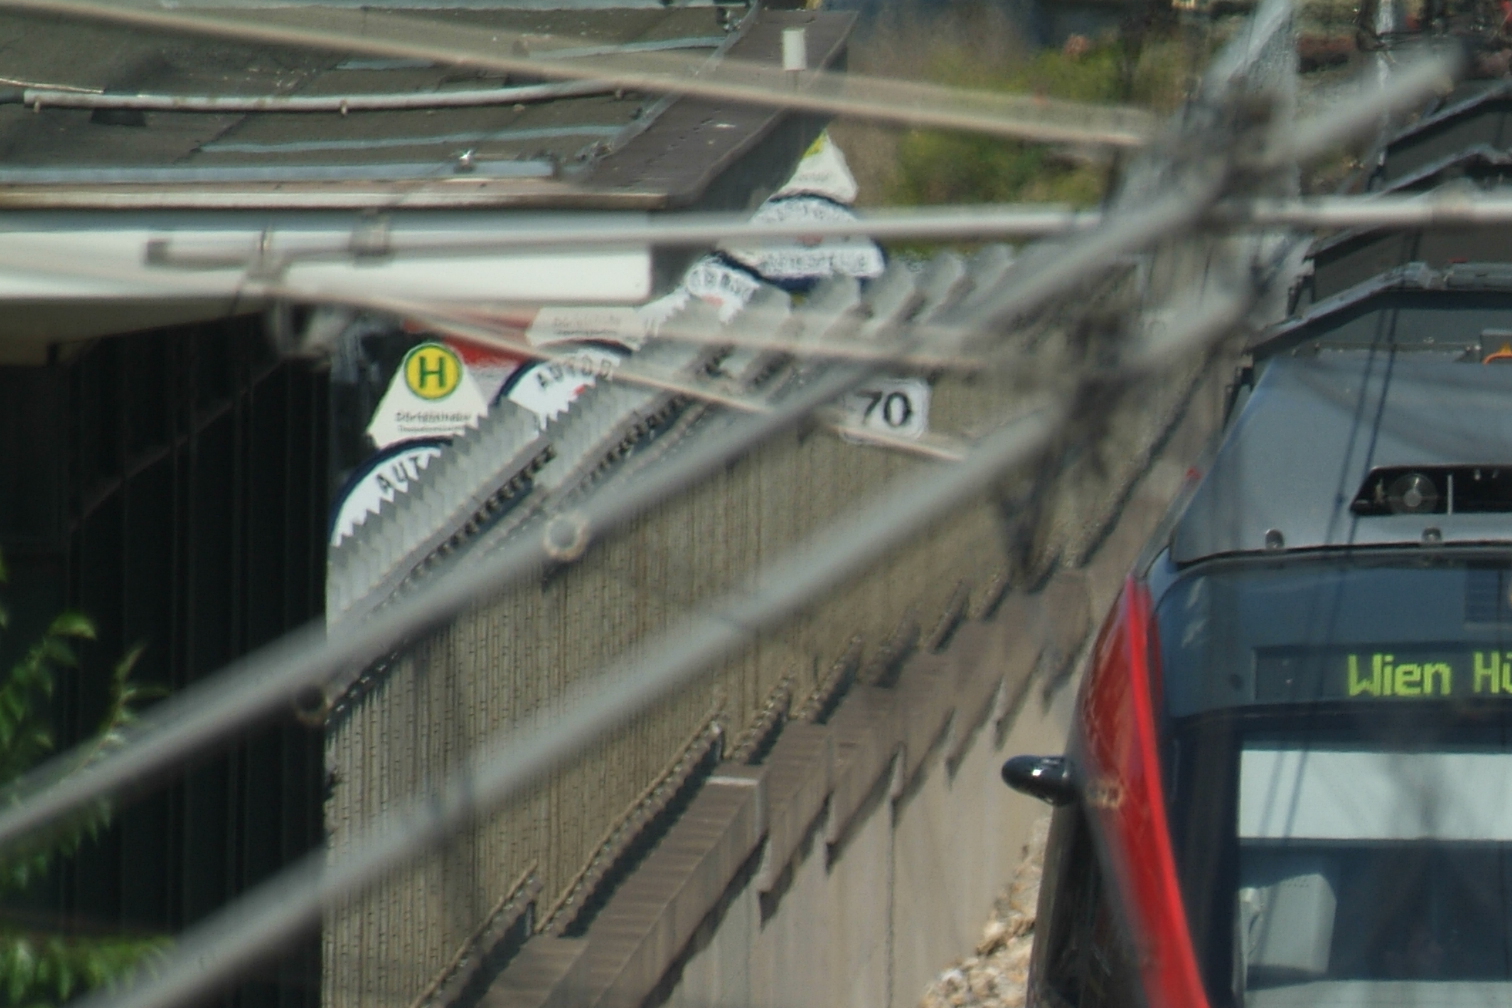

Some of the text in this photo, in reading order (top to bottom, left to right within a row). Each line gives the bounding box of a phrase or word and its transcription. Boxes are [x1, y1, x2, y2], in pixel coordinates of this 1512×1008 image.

[418, 355, 447, 389] H
[857, 390, 912, 428] 70
[1347, 653, 1452, 697] Wien
